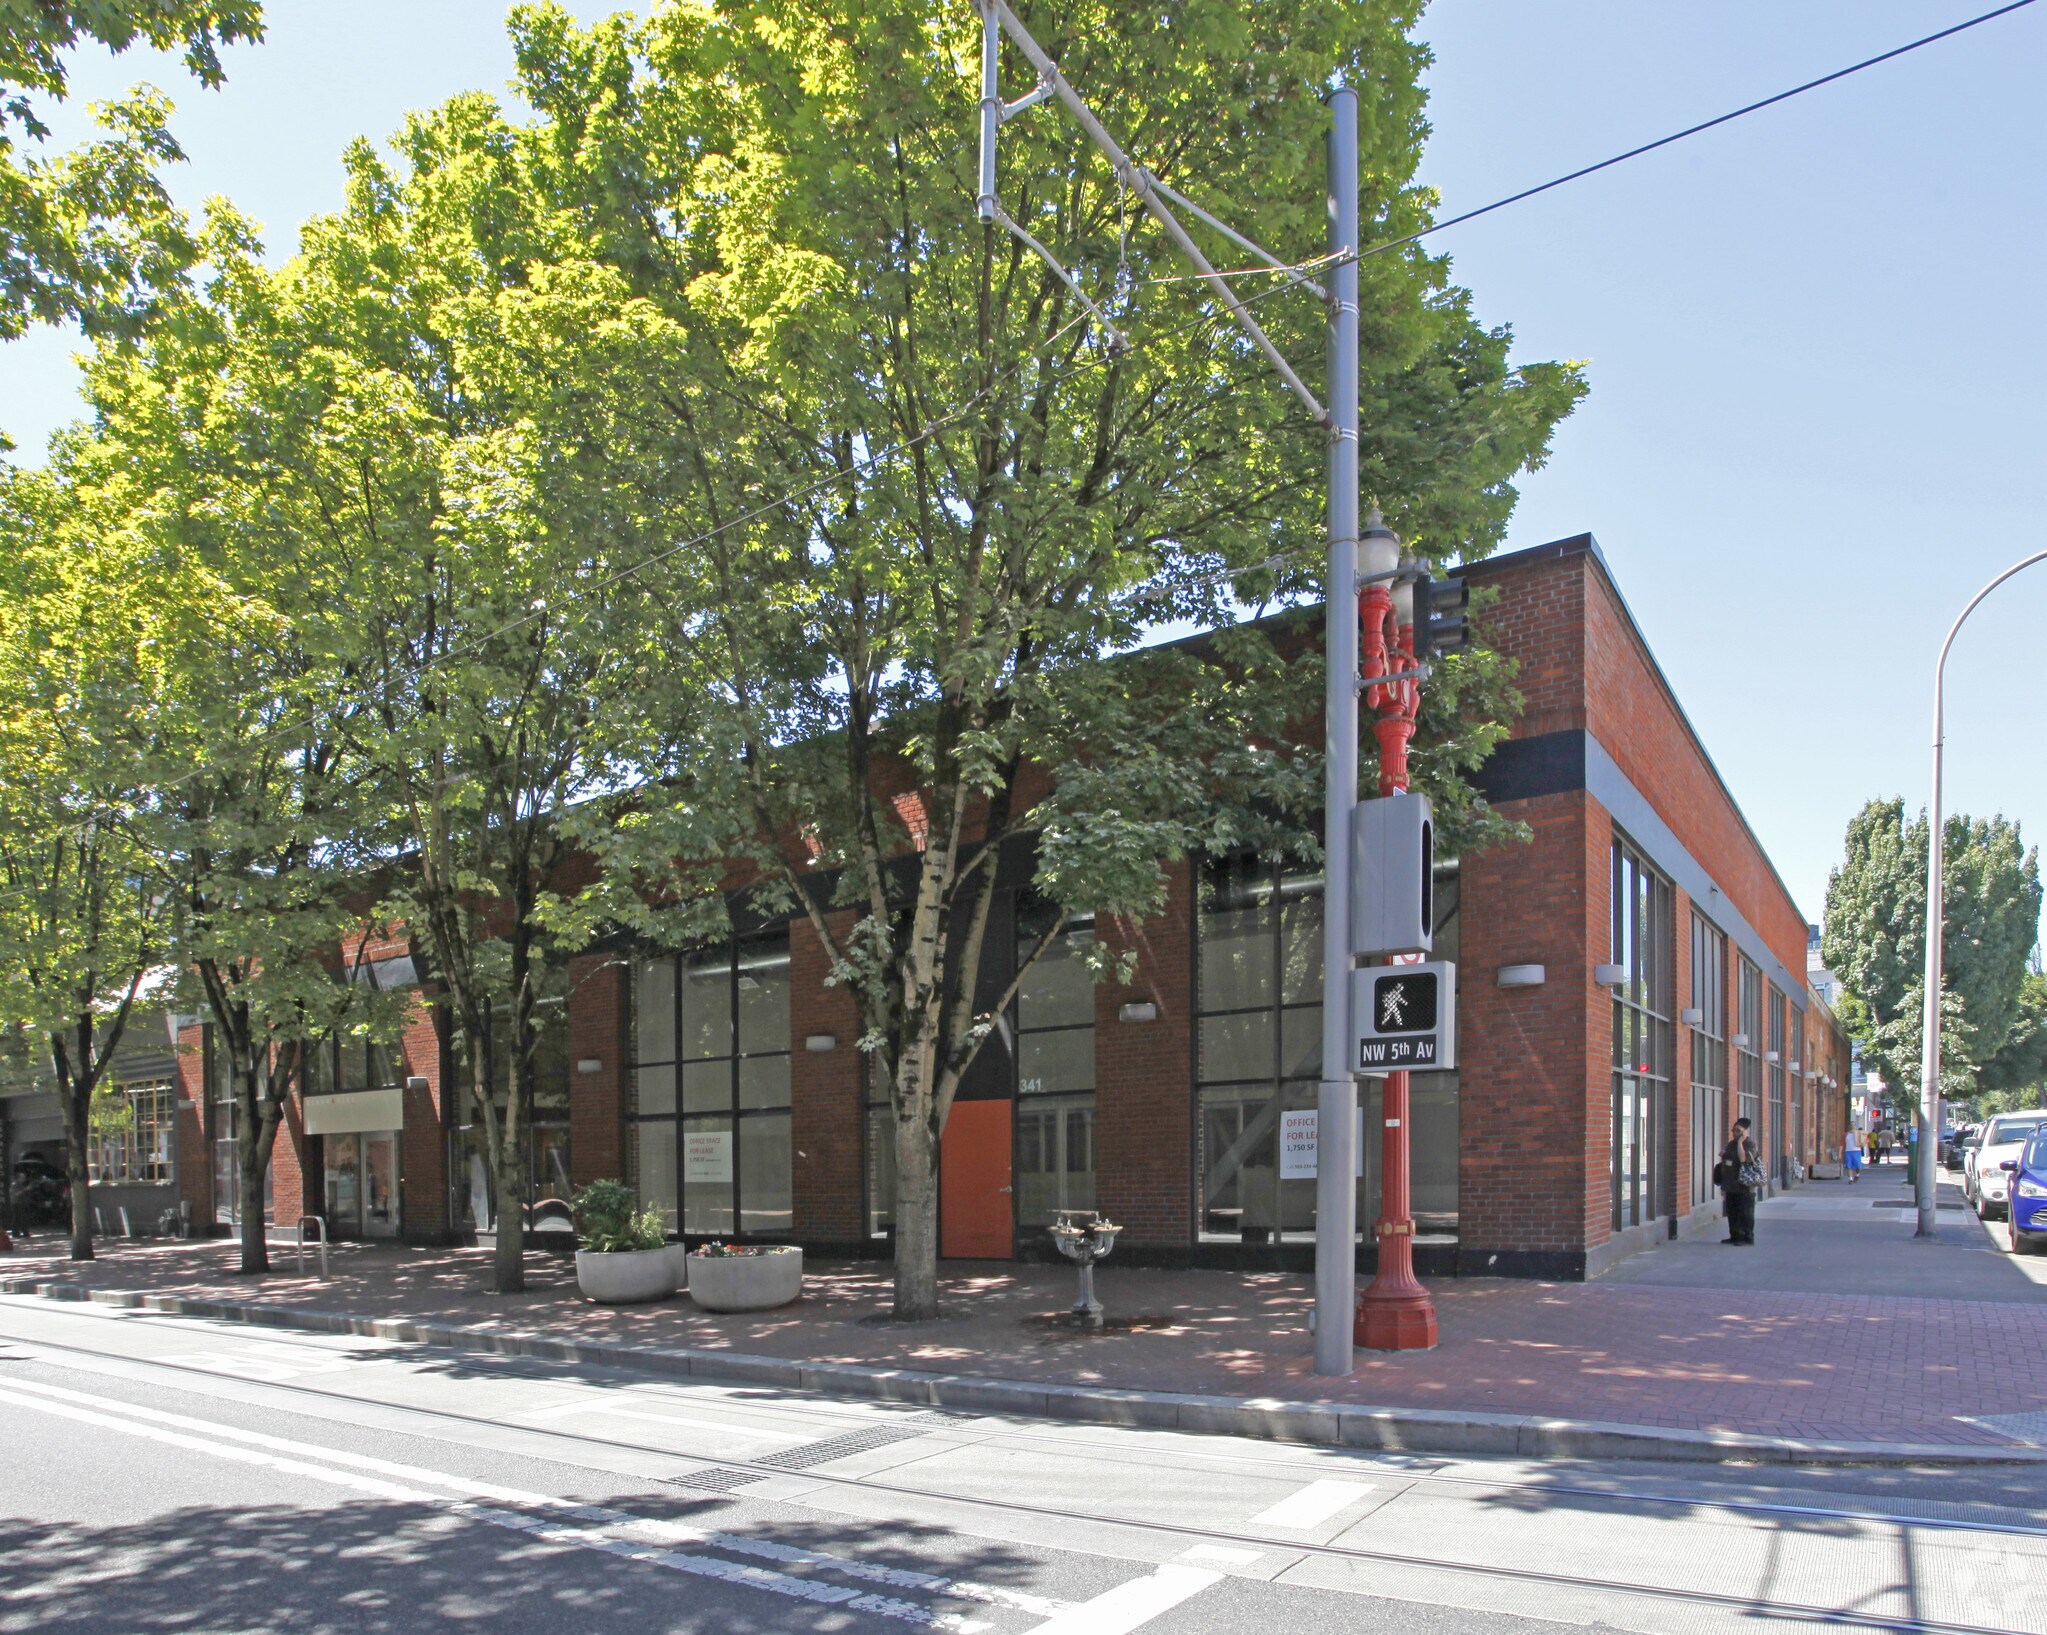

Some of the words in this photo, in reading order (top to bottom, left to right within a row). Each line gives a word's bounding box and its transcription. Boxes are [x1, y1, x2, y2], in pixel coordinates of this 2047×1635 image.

[1363, 1044, 1386, 1061] NW
[1391, 1042, 1410, 1060] 5th
[1416, 1041, 1434, 1059] Av
[1020, 1078, 1041, 1093] 341
[1286, 1117, 1316, 1127] OFFICE
[1286, 1132, 1304, 1140] FOR
[1287, 1144, 1306, 1152] 1,750
[146, 1343, 394, 1381] BUS
